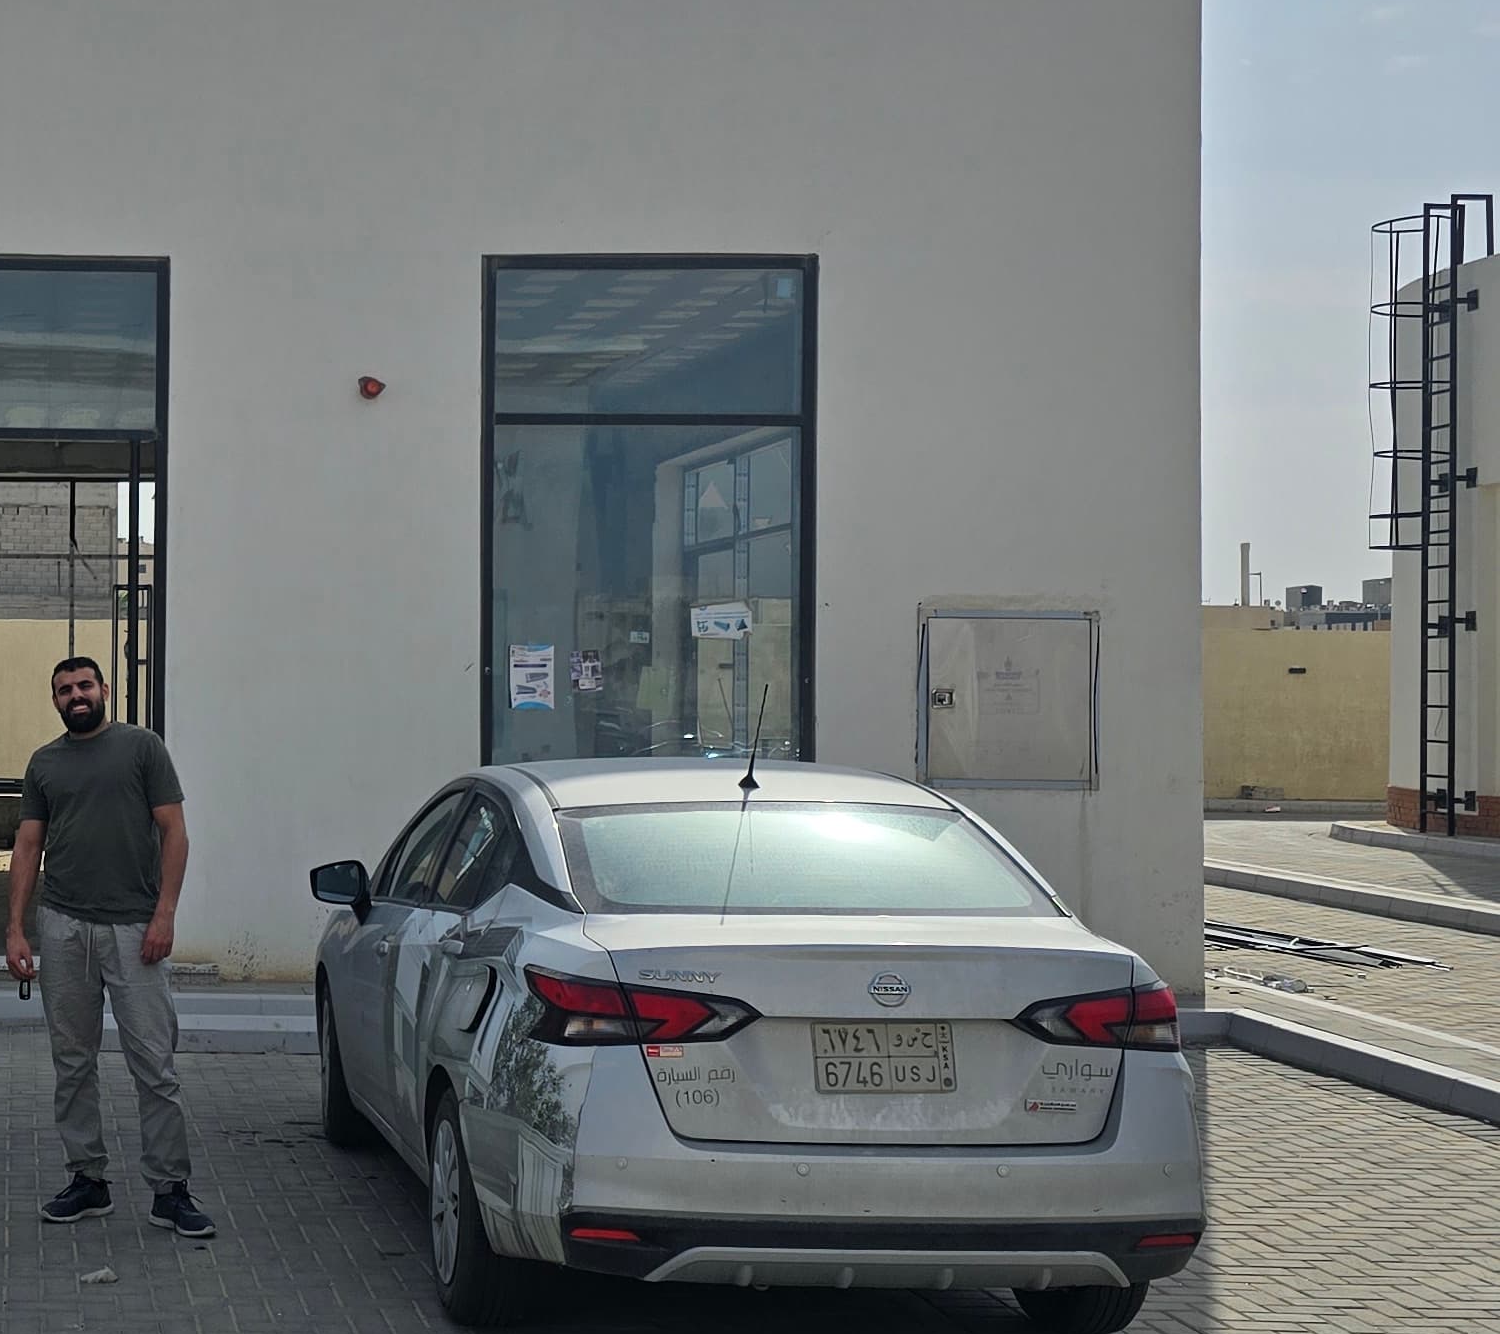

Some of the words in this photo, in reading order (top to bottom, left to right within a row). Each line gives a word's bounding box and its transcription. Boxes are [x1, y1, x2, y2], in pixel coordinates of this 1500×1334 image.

[638, 969, 722, 983] SUNNY
[657, 1067, 701, 1086] السيارة
[707, 1067, 736, 1084] رقم
[824, 1061, 883, 1088] 6746
[675, 1088, 720, 1108] (106)
